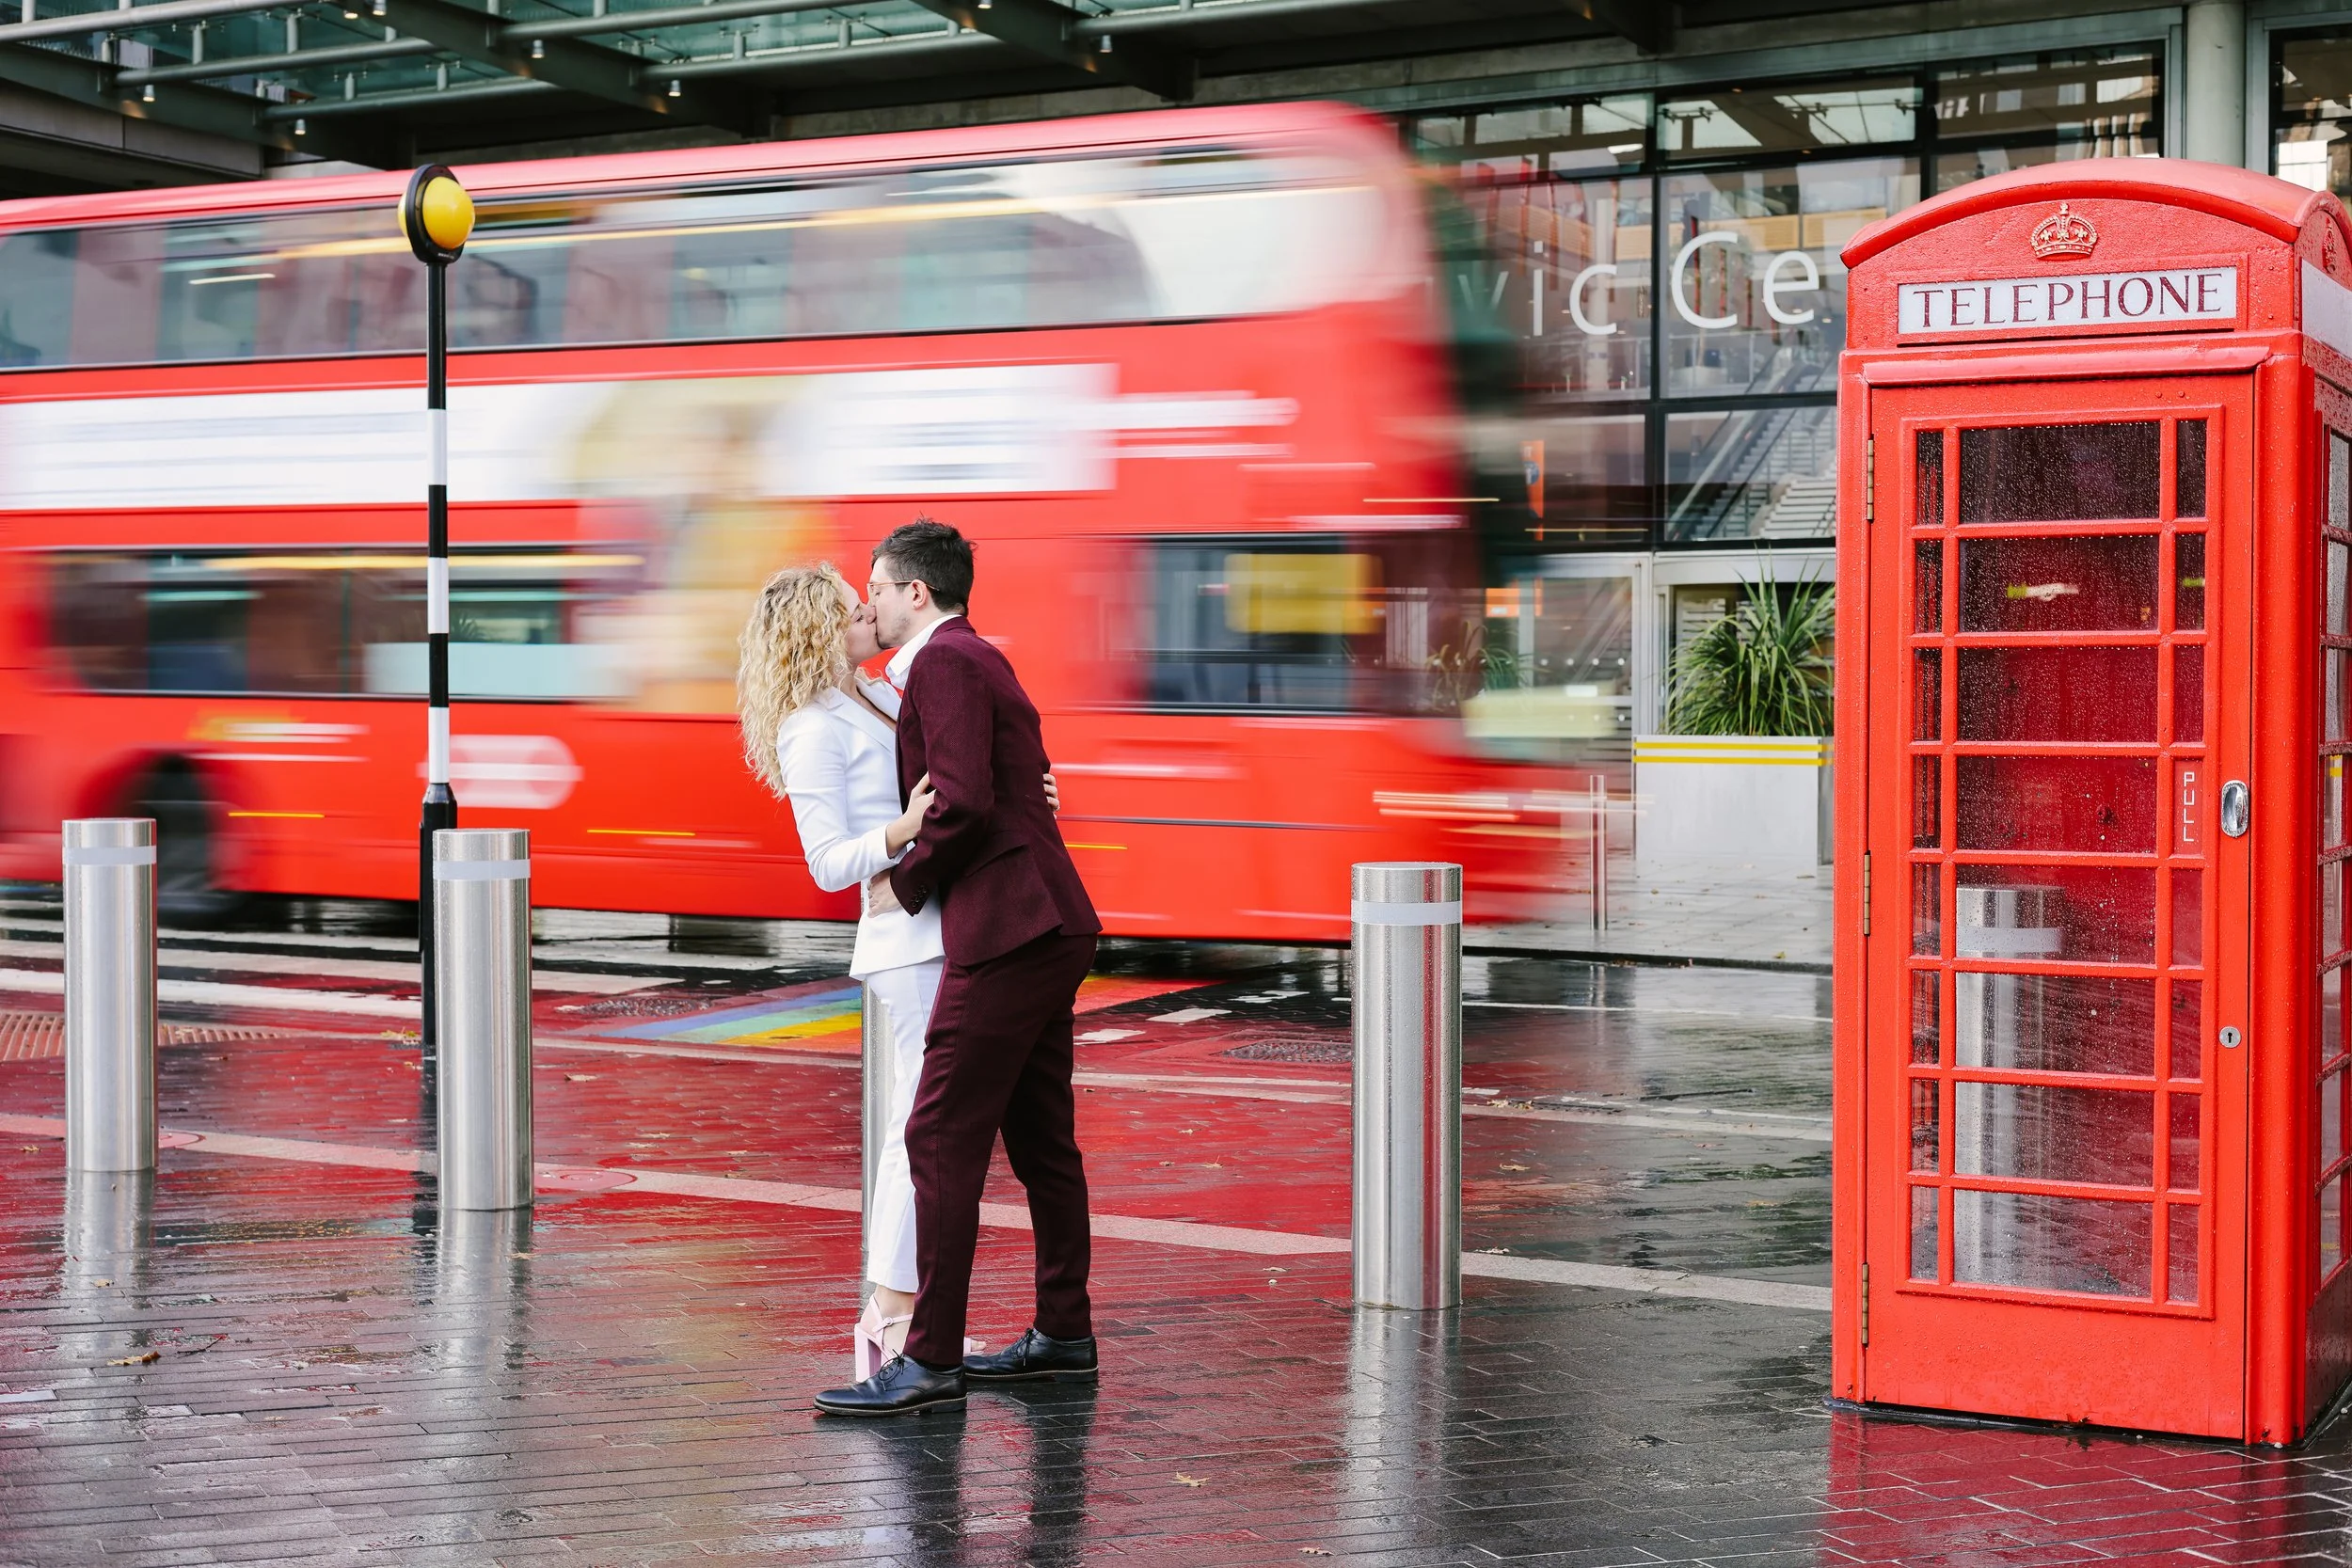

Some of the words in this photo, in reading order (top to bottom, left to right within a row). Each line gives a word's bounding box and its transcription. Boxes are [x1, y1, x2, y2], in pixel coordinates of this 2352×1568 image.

[1671, 230, 1820, 329] Ce
[1913, 273, 2223, 327] TELEPHONE
[2183, 771, 2195, 842] PULL
